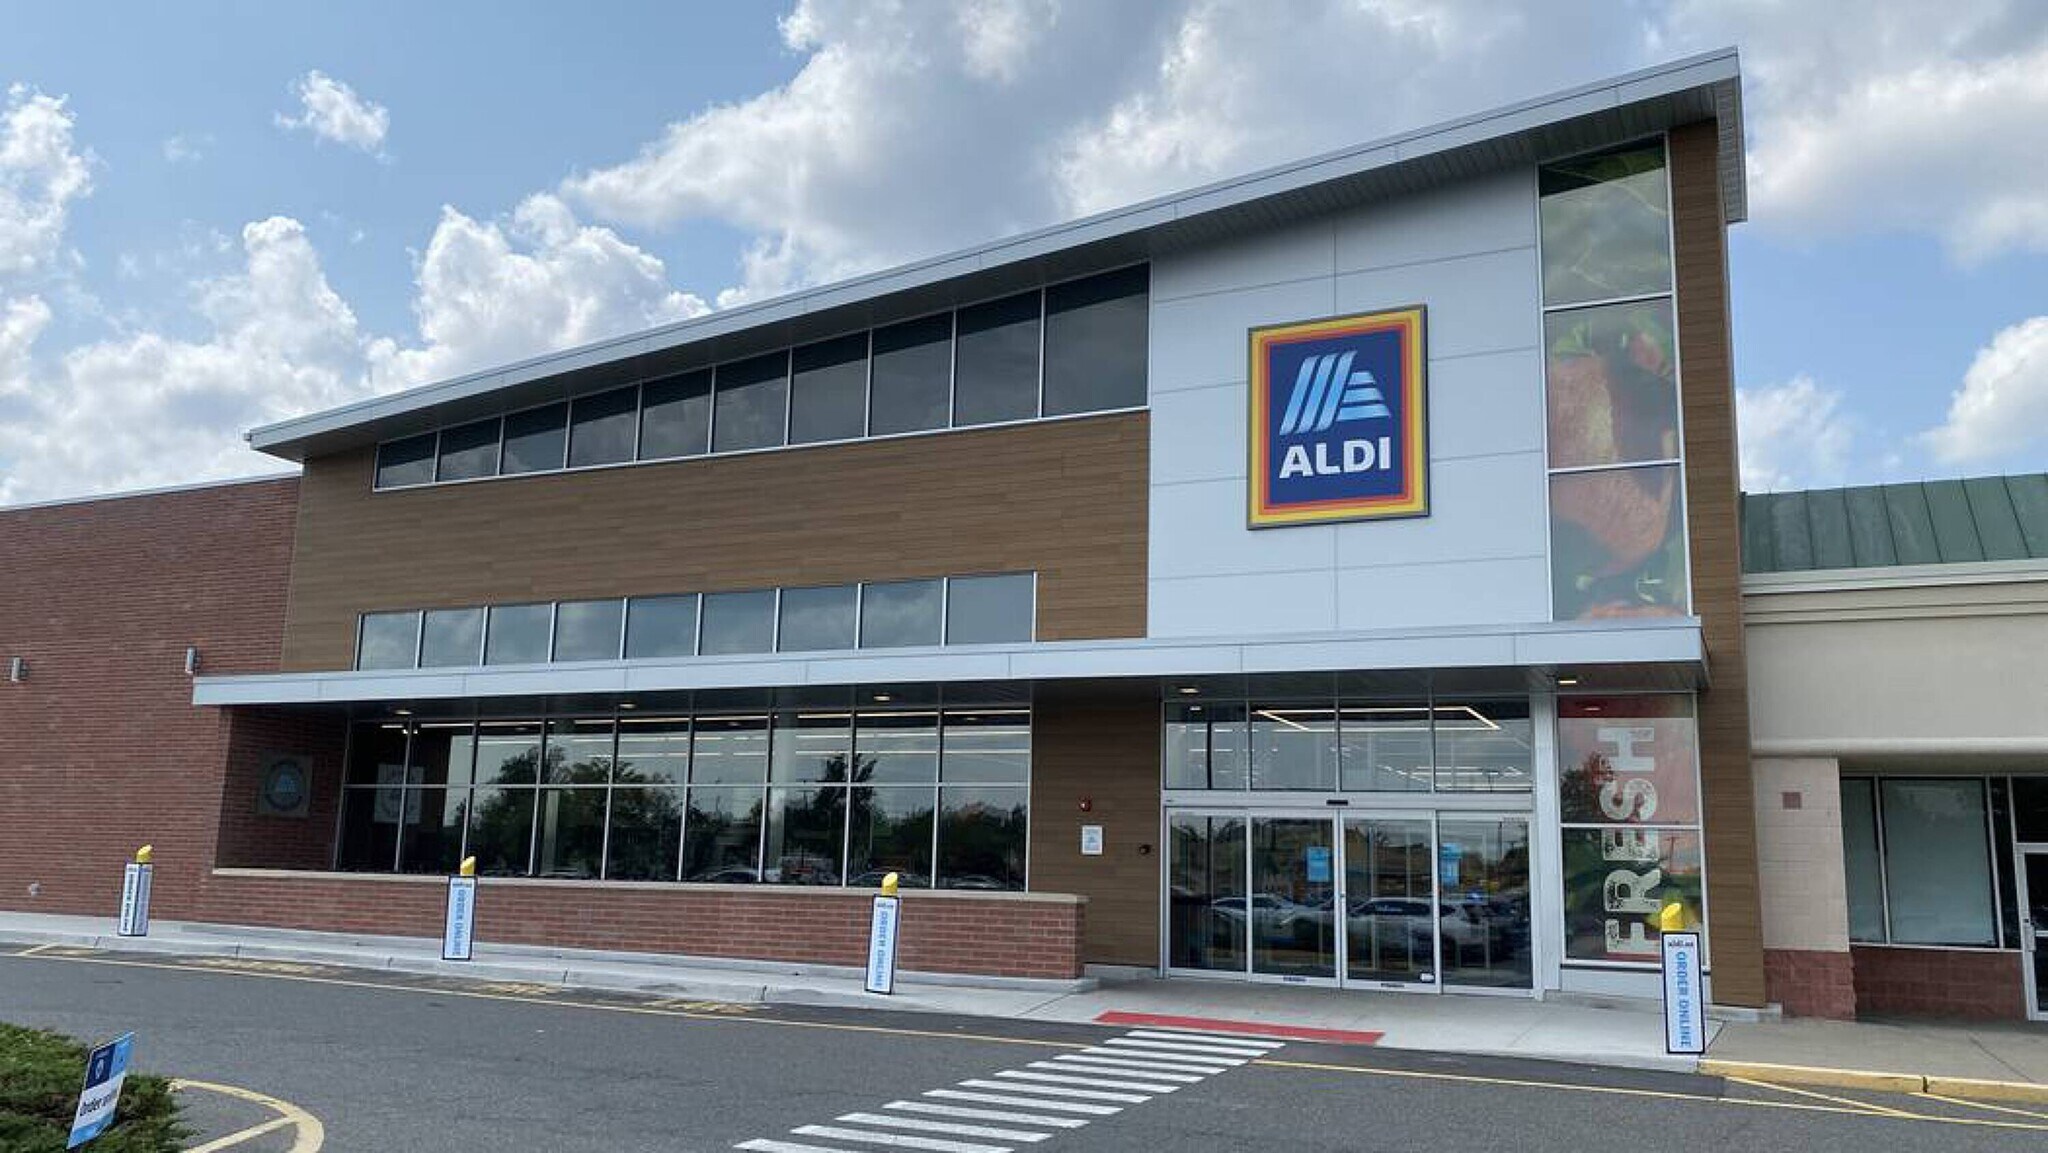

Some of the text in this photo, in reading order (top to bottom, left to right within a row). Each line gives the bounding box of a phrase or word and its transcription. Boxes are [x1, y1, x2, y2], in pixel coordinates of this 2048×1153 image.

[1279, 436, 1391, 479] ALDI
[1597, 727, 1662, 953] FRESH
[1676, 952, 1693, 1047] ORDER ONLINE
